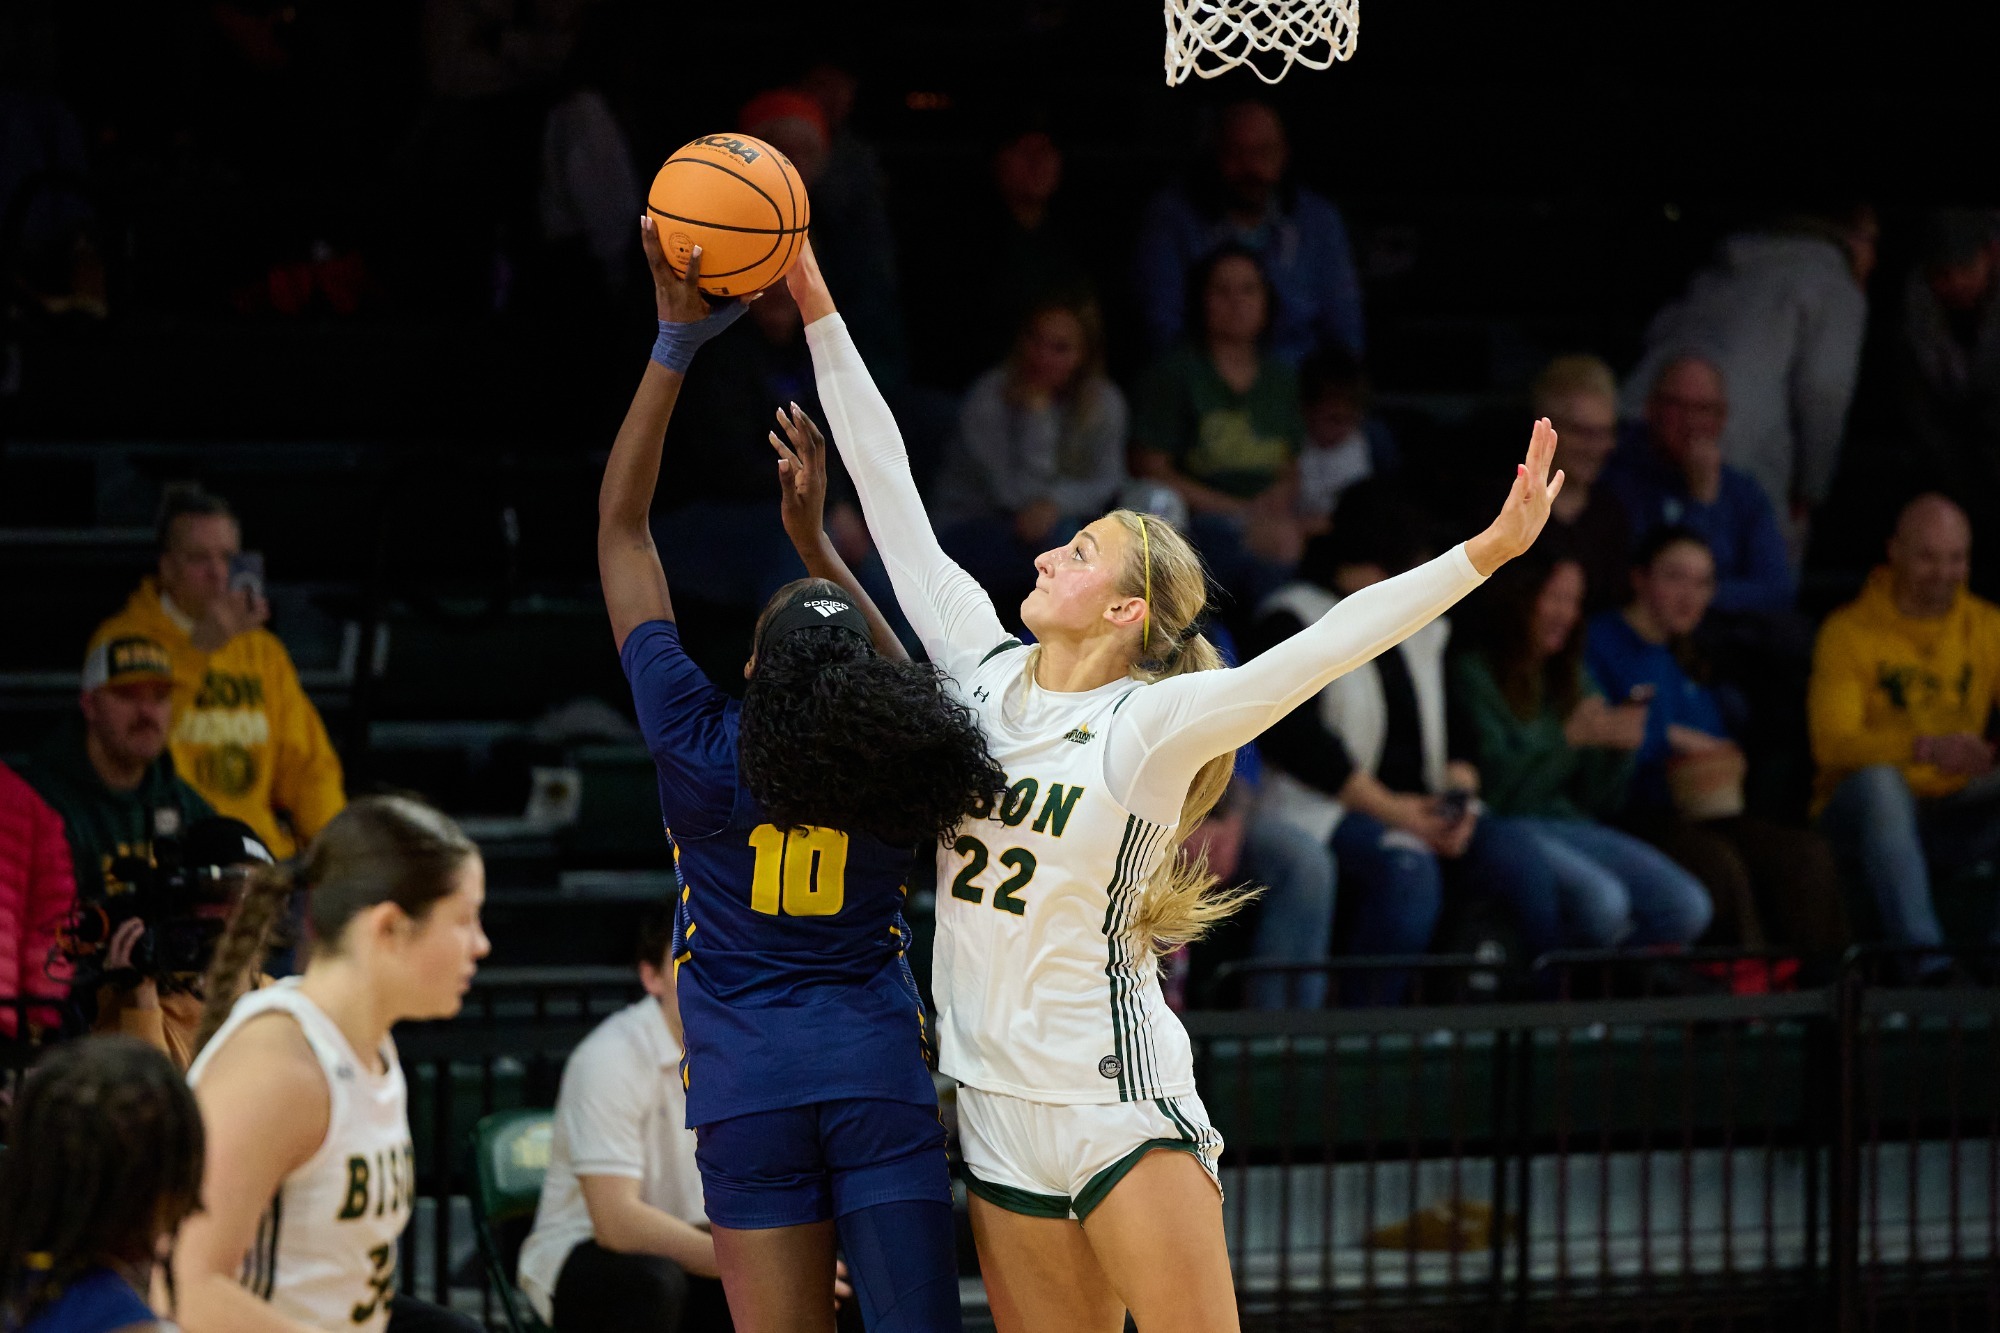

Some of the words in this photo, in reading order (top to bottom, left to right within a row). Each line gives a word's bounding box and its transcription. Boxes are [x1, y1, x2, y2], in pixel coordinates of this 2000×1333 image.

[803, 600, 849, 610] adidas
[748, 823, 849, 916] 10
[951, 835, 1037, 916] 22
